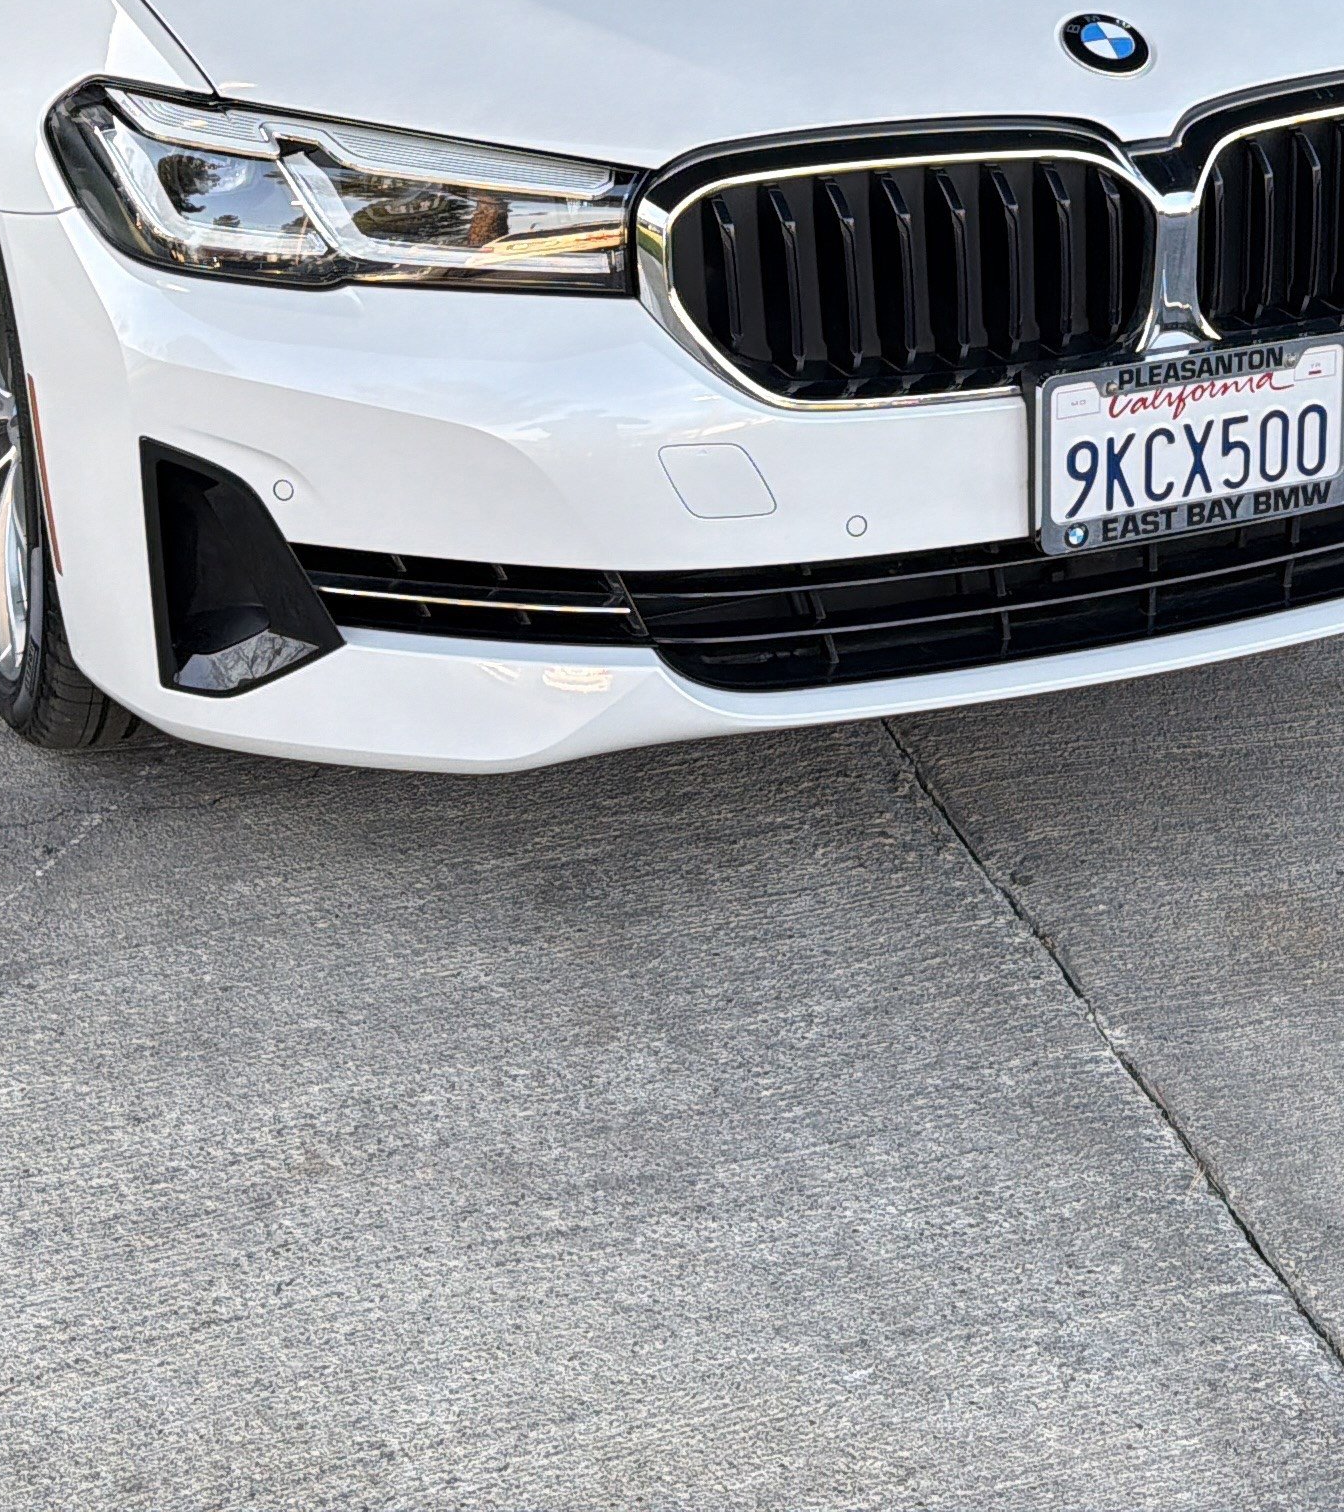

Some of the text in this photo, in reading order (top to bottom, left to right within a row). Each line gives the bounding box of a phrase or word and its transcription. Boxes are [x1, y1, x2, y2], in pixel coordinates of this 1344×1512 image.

[1108, 371, 1294, 420] California
[1119, 346, 1284, 391] PLEASANTON
[1064, 404, 1328, 518] 9KCX500
[1102, 482, 1330, 542] EAST BAY BMW
